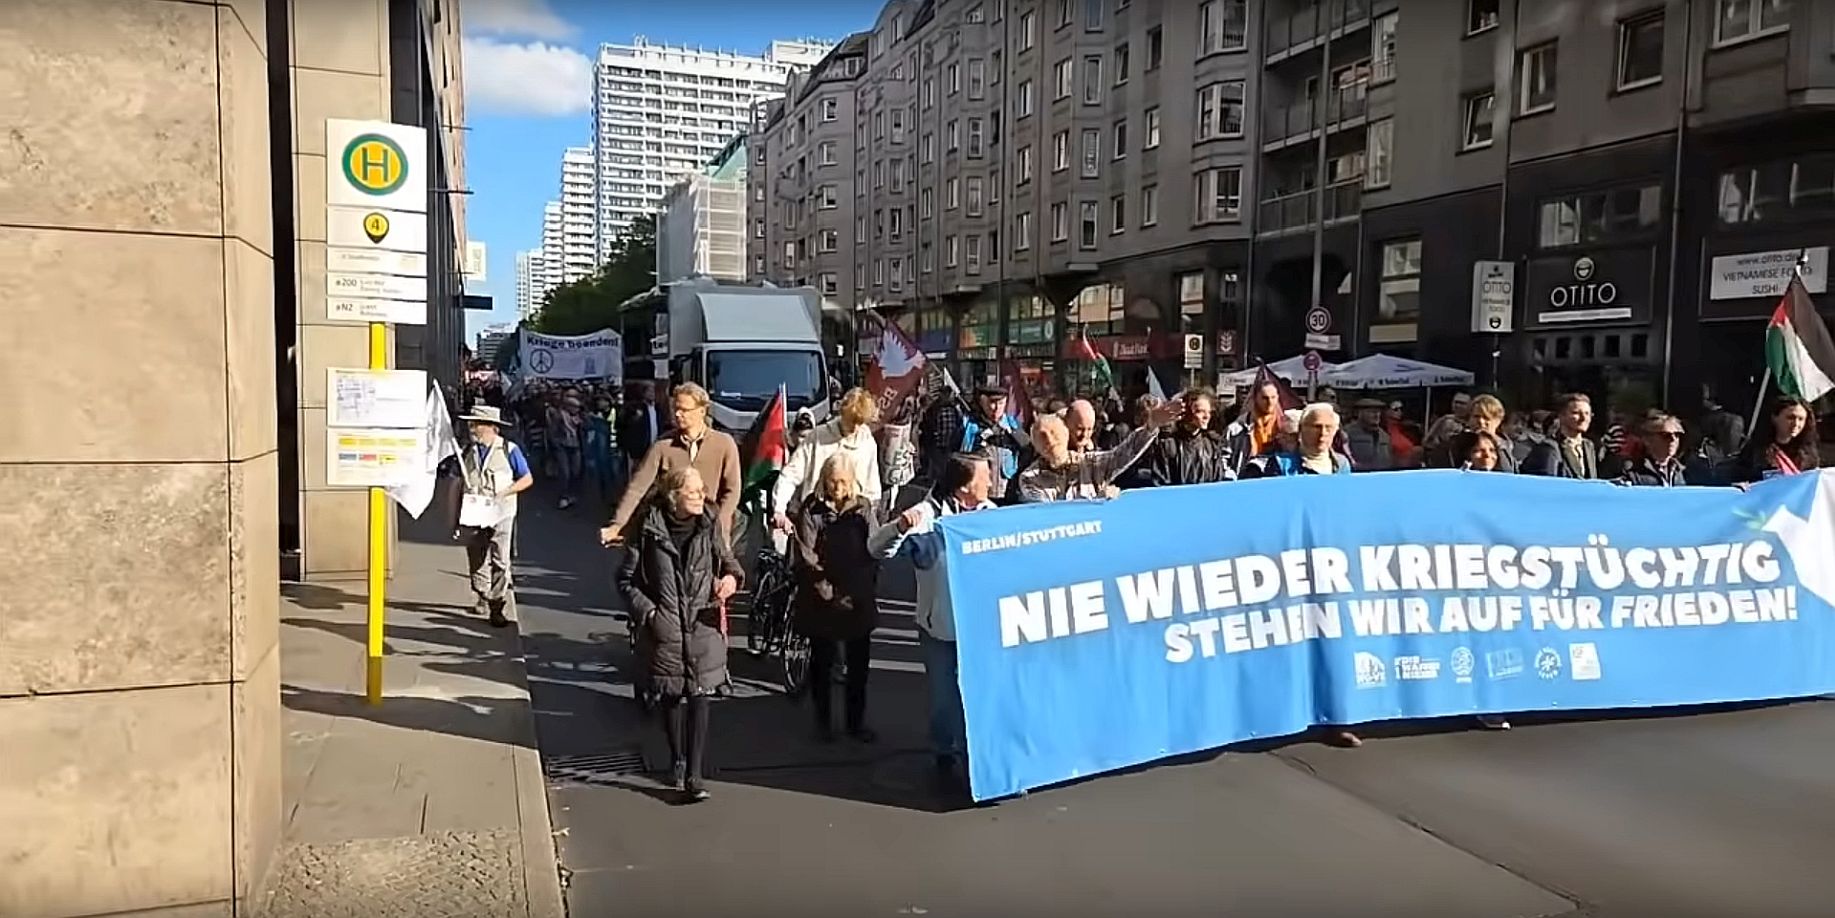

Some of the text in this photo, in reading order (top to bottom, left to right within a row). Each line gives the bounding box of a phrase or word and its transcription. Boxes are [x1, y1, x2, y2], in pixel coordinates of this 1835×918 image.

[361, 147, 389, 182] H
[370, 218, 380, 231] 4
[1722, 267, 1778, 282] VIETNAMESE
[341, 278, 357, 287] 200
[1752, 284, 1779, 295] SUSHI
[1550, 282, 1617, 308] OTITO
[341, 303, 353, 312] N2
[1311, 311, 1325, 327] 30
[526, 336, 565, 349] Kriege
[961, 519, 1102, 555] BERLIN/STUTTGART
[999, 533, 1780, 649] NIE WIEDER KRIEGSTÜCHTIG
[1164, 585, 1798, 663] STEHEN WIR AUF FÜR FRIEDEN!
